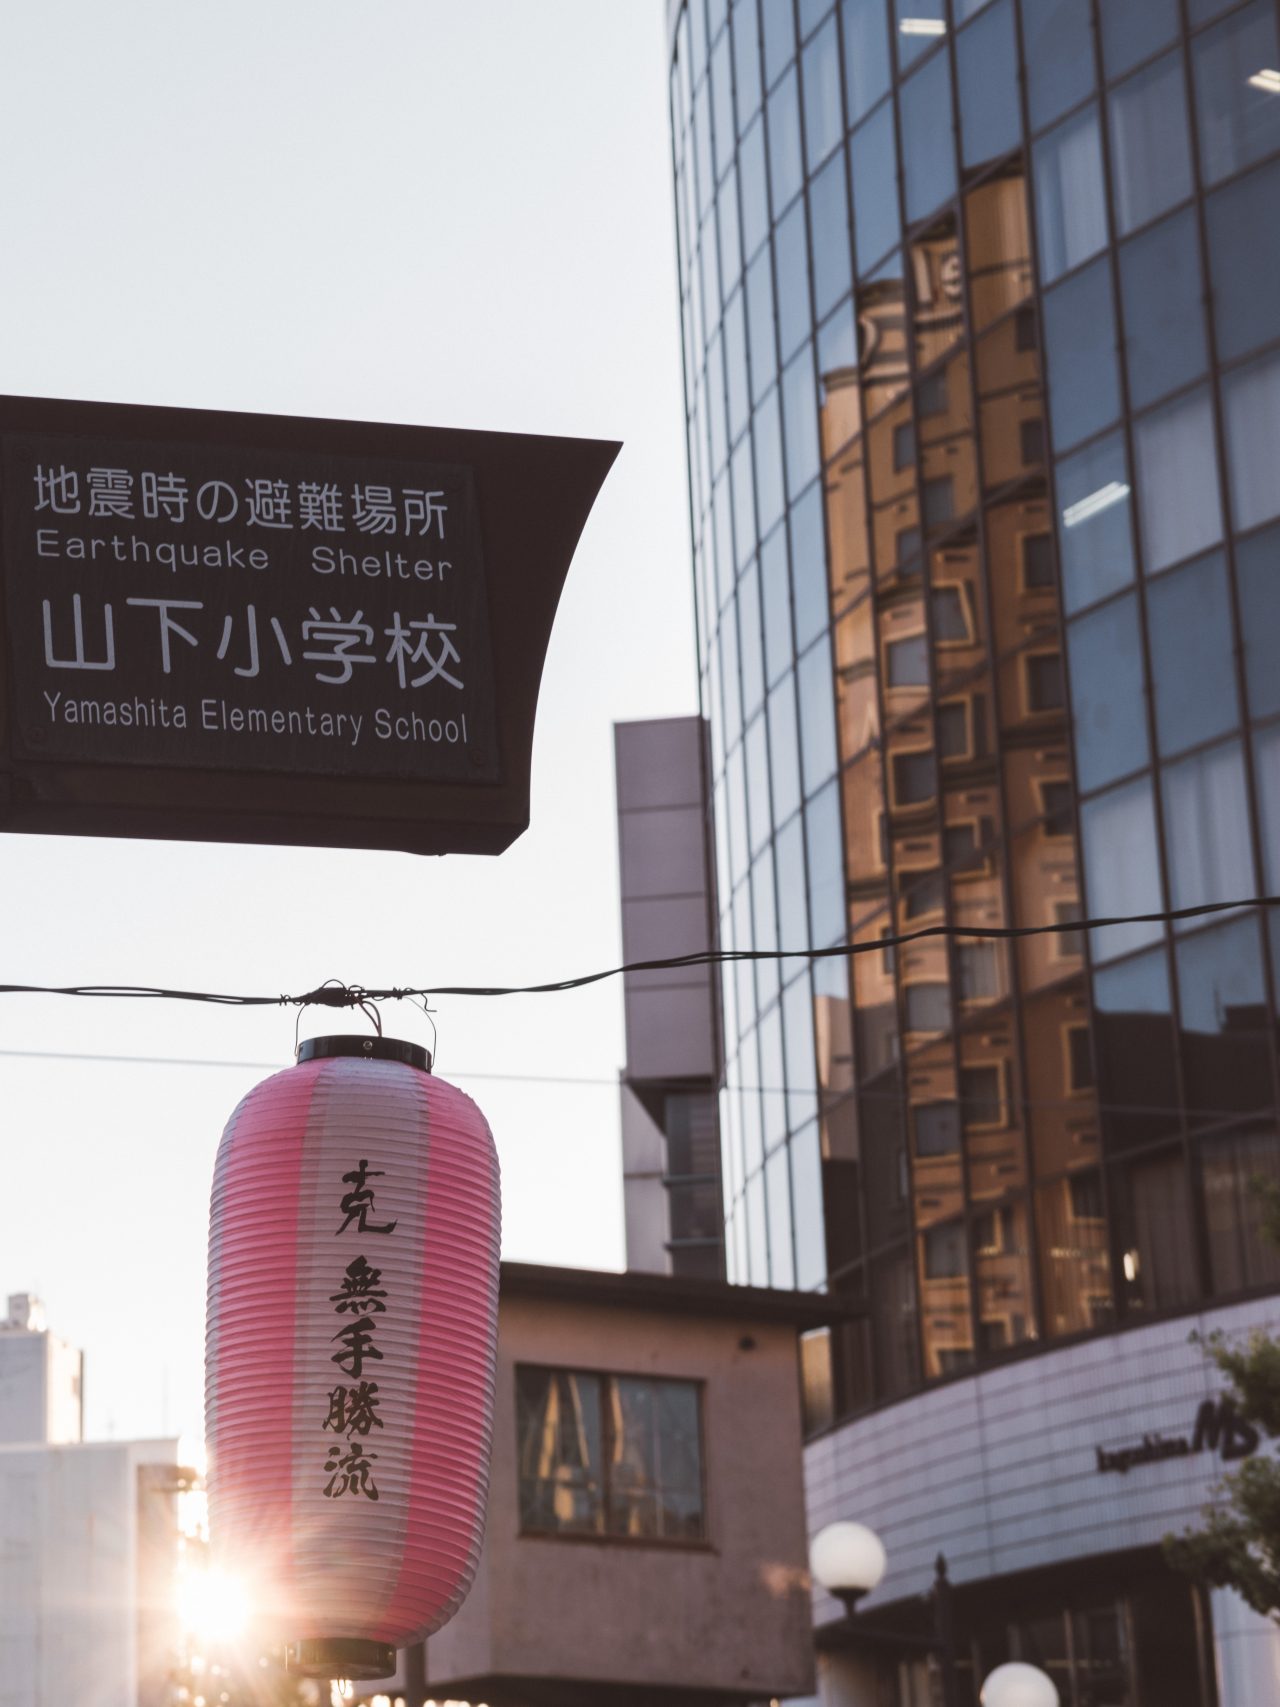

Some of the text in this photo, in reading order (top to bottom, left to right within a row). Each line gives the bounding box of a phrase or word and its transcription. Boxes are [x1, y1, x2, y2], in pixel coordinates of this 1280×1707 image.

[33, 464, 448, 539] 地震時の避難場所
[36, 529, 452, 581] Earthquake Shelter
[42, 593, 465, 690] 山下小学校
[43, 691, 468, 746] Yamashita Elementary School
[322, 1255, 389, 1501] 無手勝流
